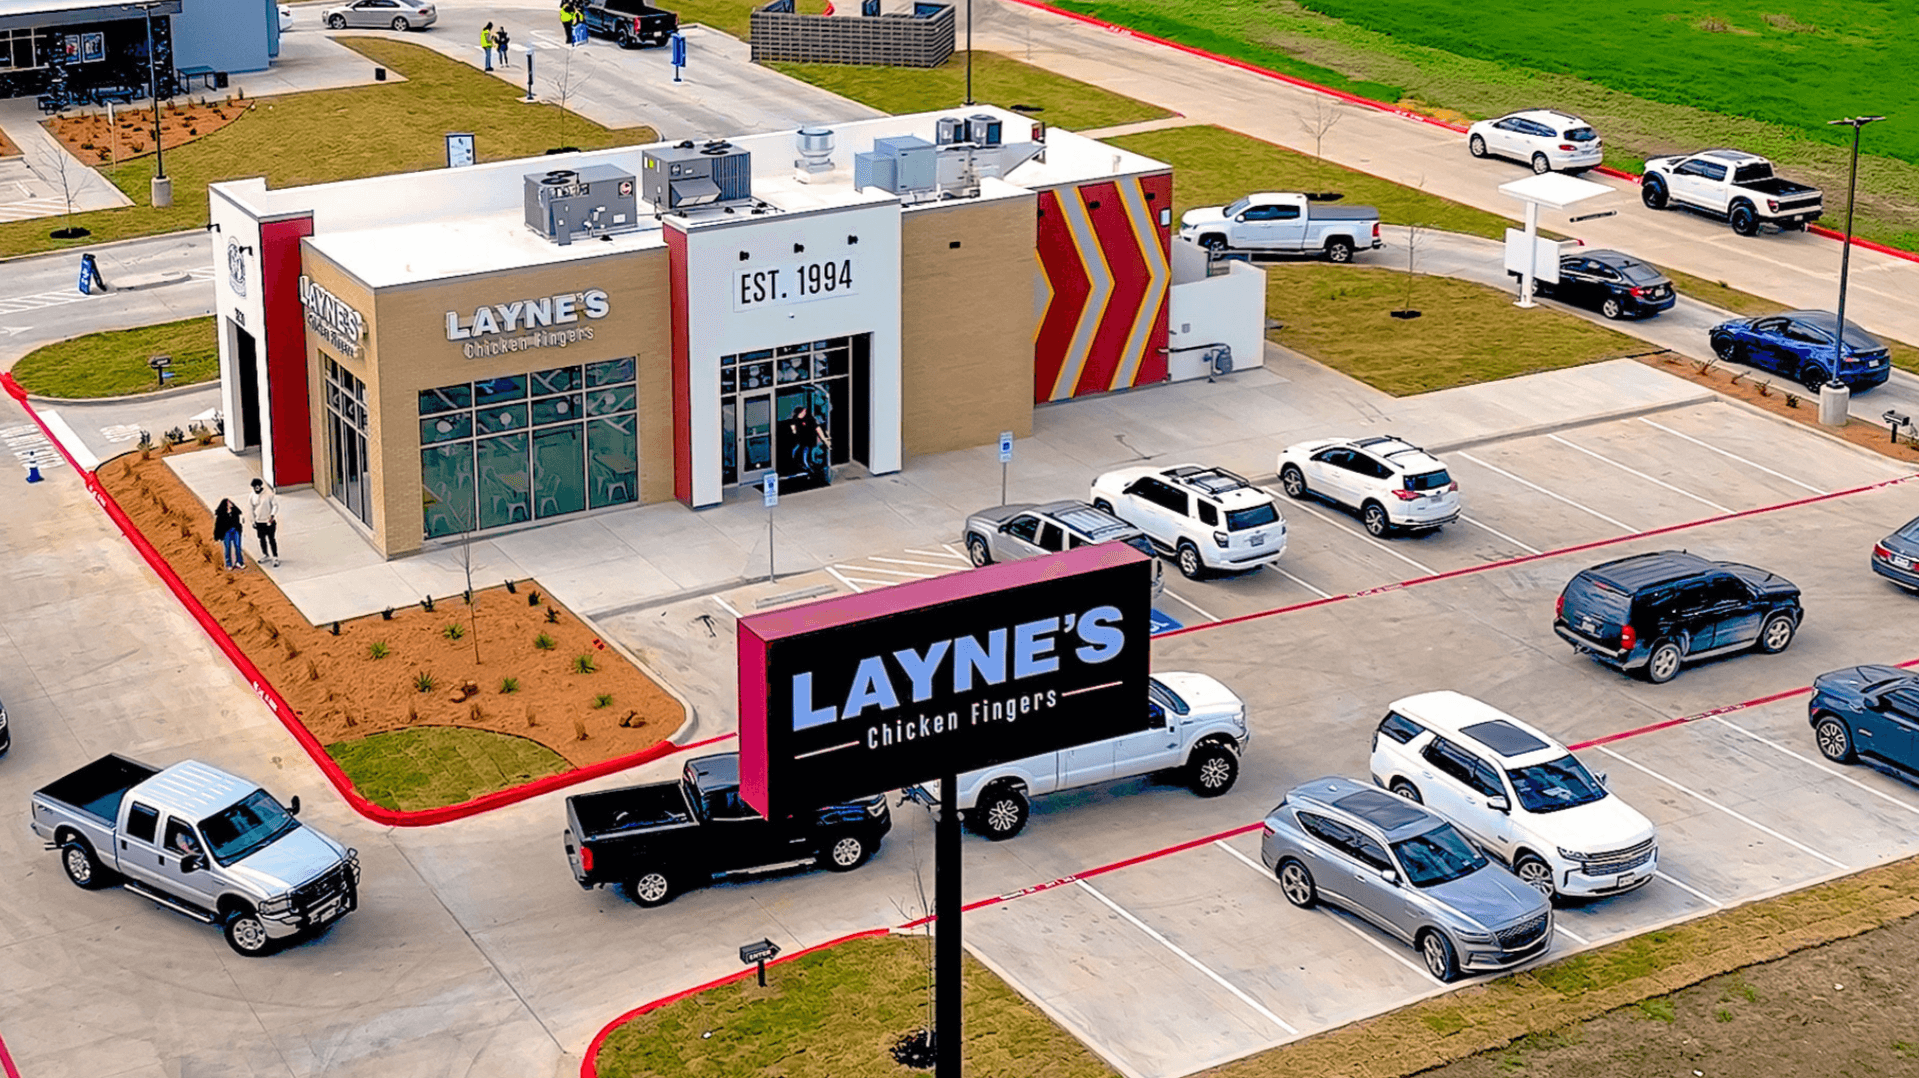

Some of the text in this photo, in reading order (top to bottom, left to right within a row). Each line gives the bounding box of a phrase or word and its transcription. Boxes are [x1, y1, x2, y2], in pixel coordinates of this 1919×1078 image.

[741, 259, 853, 304] EST. 1994
[446, 289, 610, 341] LAYNE'S
[463, 326, 595, 359] Chicken Fingers
[792, 605, 1125, 731] LAYNE'S
[867, 690, 1057, 749] Chicken Fingers
